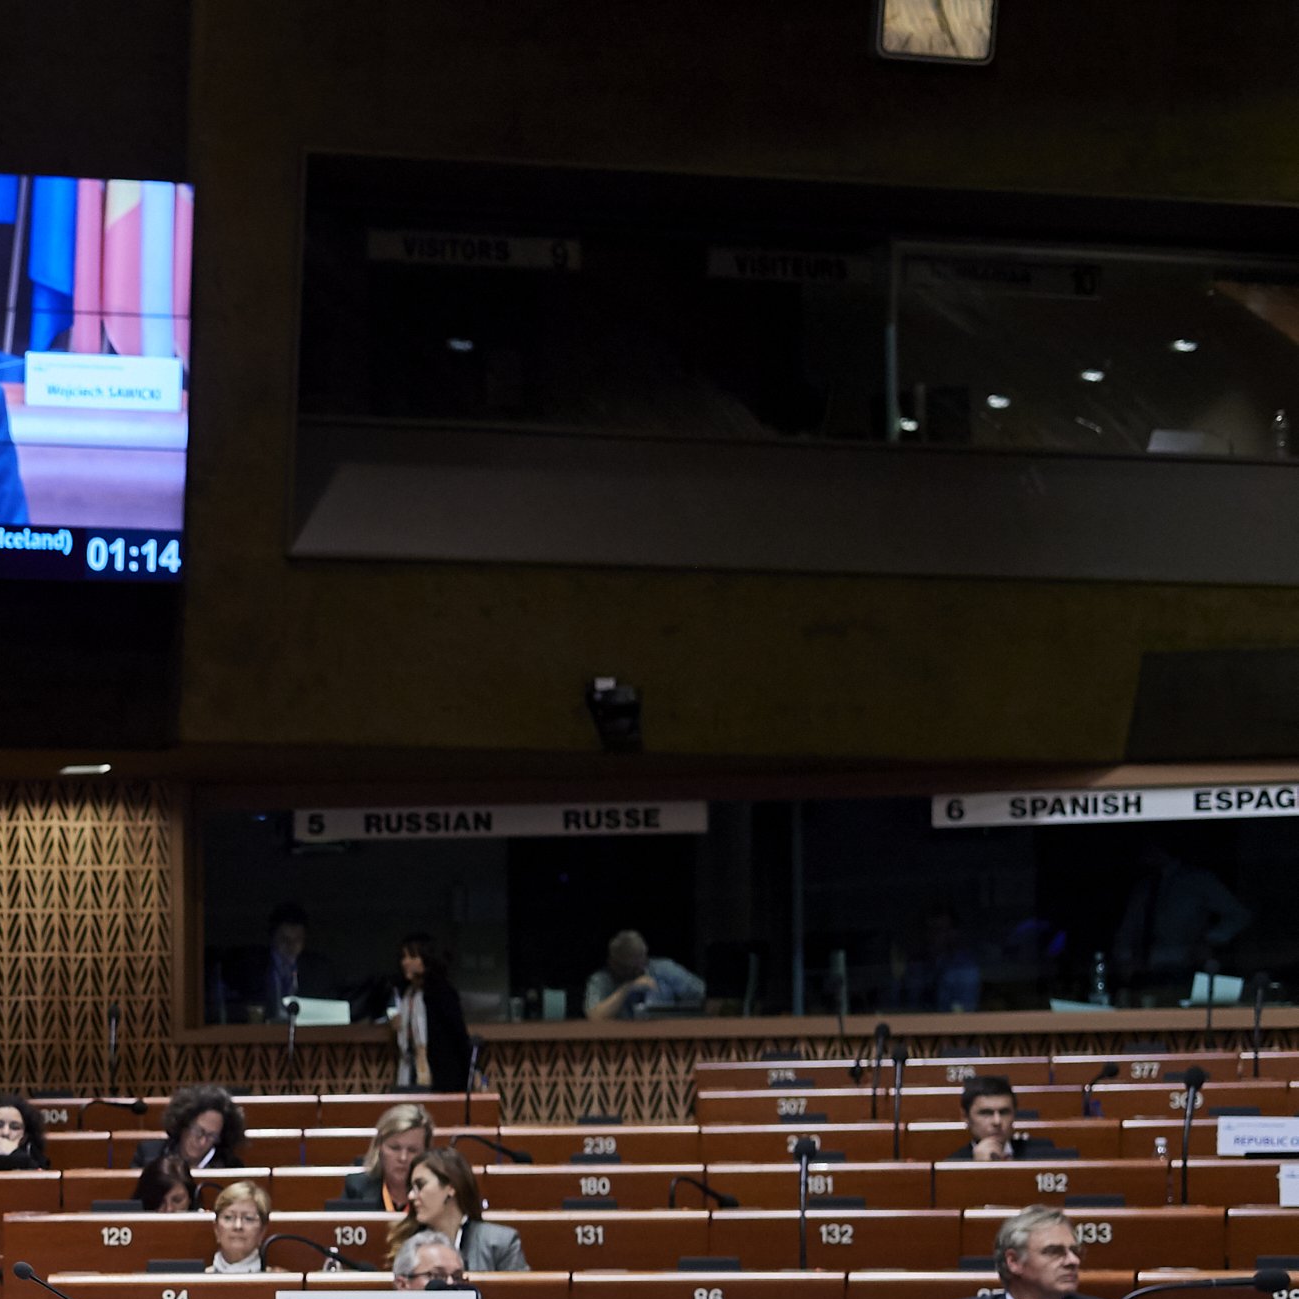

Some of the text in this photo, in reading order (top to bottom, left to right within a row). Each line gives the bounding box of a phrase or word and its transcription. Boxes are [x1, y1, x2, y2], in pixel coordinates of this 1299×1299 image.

[402, 236, 567, 268] VISITORS 9
[86, 536, 183, 573] 01:14
[946, 800, 964, 821] 6
[1010, 793, 1142, 818] SPANISH
[307, 809, 661, 835] 5 RUSSIAN RUSSE
[1130, 1062, 1161, 1079] 377
[777, 1098, 808, 1115] 307
[583, 1136, 617, 1155] 239
[1233, 1134, 1288, 1147] REPUBLIC
[579, 1176, 610, 1196] 180
[806, 1175, 834, 1194] 181
[1035, 1172, 1068, 1193] 182
[101, 1227, 132, 1247] 129
[335, 1226, 367, 1246] 130
[575, 1226, 604, 1245] 131
[819, 1224, 854, 1245] 132
